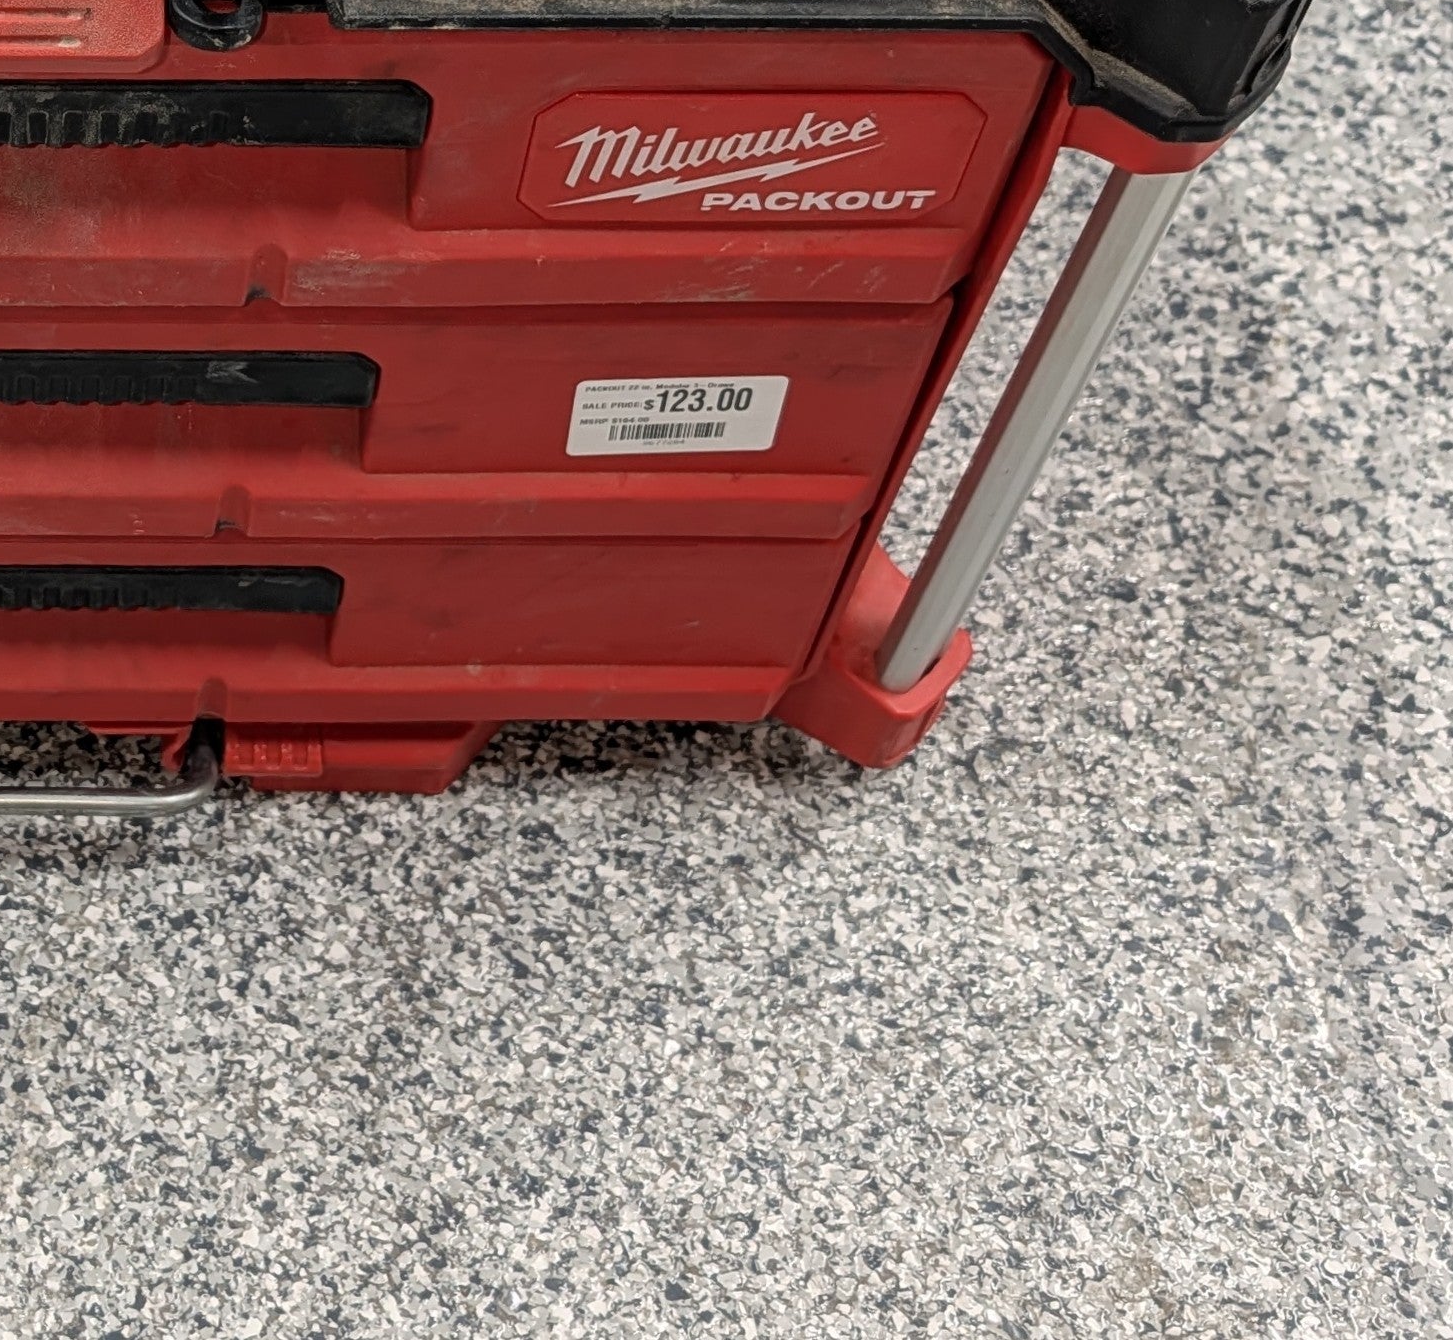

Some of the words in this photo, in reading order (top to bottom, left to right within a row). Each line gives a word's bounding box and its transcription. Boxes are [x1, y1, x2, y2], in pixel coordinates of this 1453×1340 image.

[554, 112, 880, 187] Milwaukee
[700, 190, 936, 211] PACKOUT
[582, 402, 607, 410] SALE
[644, 387, 753, 412] $123.00
[585, 384, 626, 392] PACKOUT
